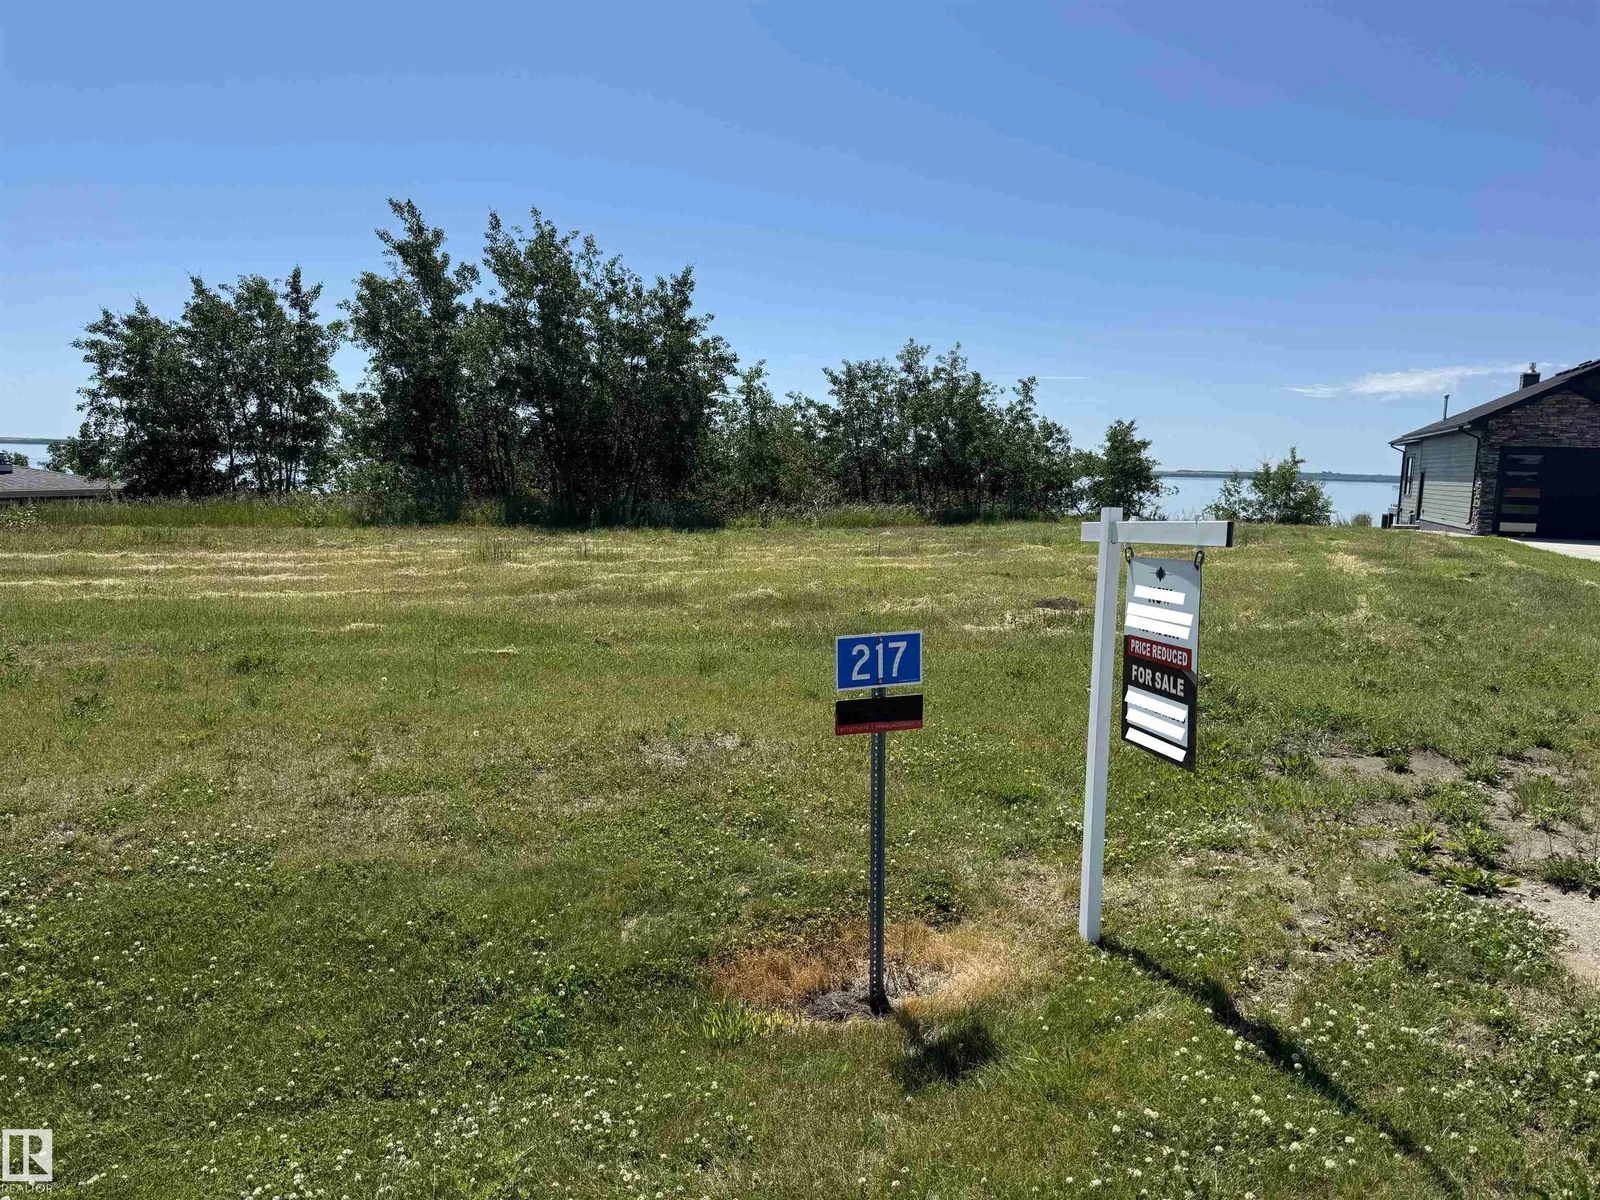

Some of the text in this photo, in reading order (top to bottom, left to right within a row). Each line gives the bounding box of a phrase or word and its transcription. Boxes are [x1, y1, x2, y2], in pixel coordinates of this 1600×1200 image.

[851, 641, 907, 681] 217
[1130, 639, 1188, 666] PRICE REDUCED
[1131, 664, 1185, 697] FOR SALE
